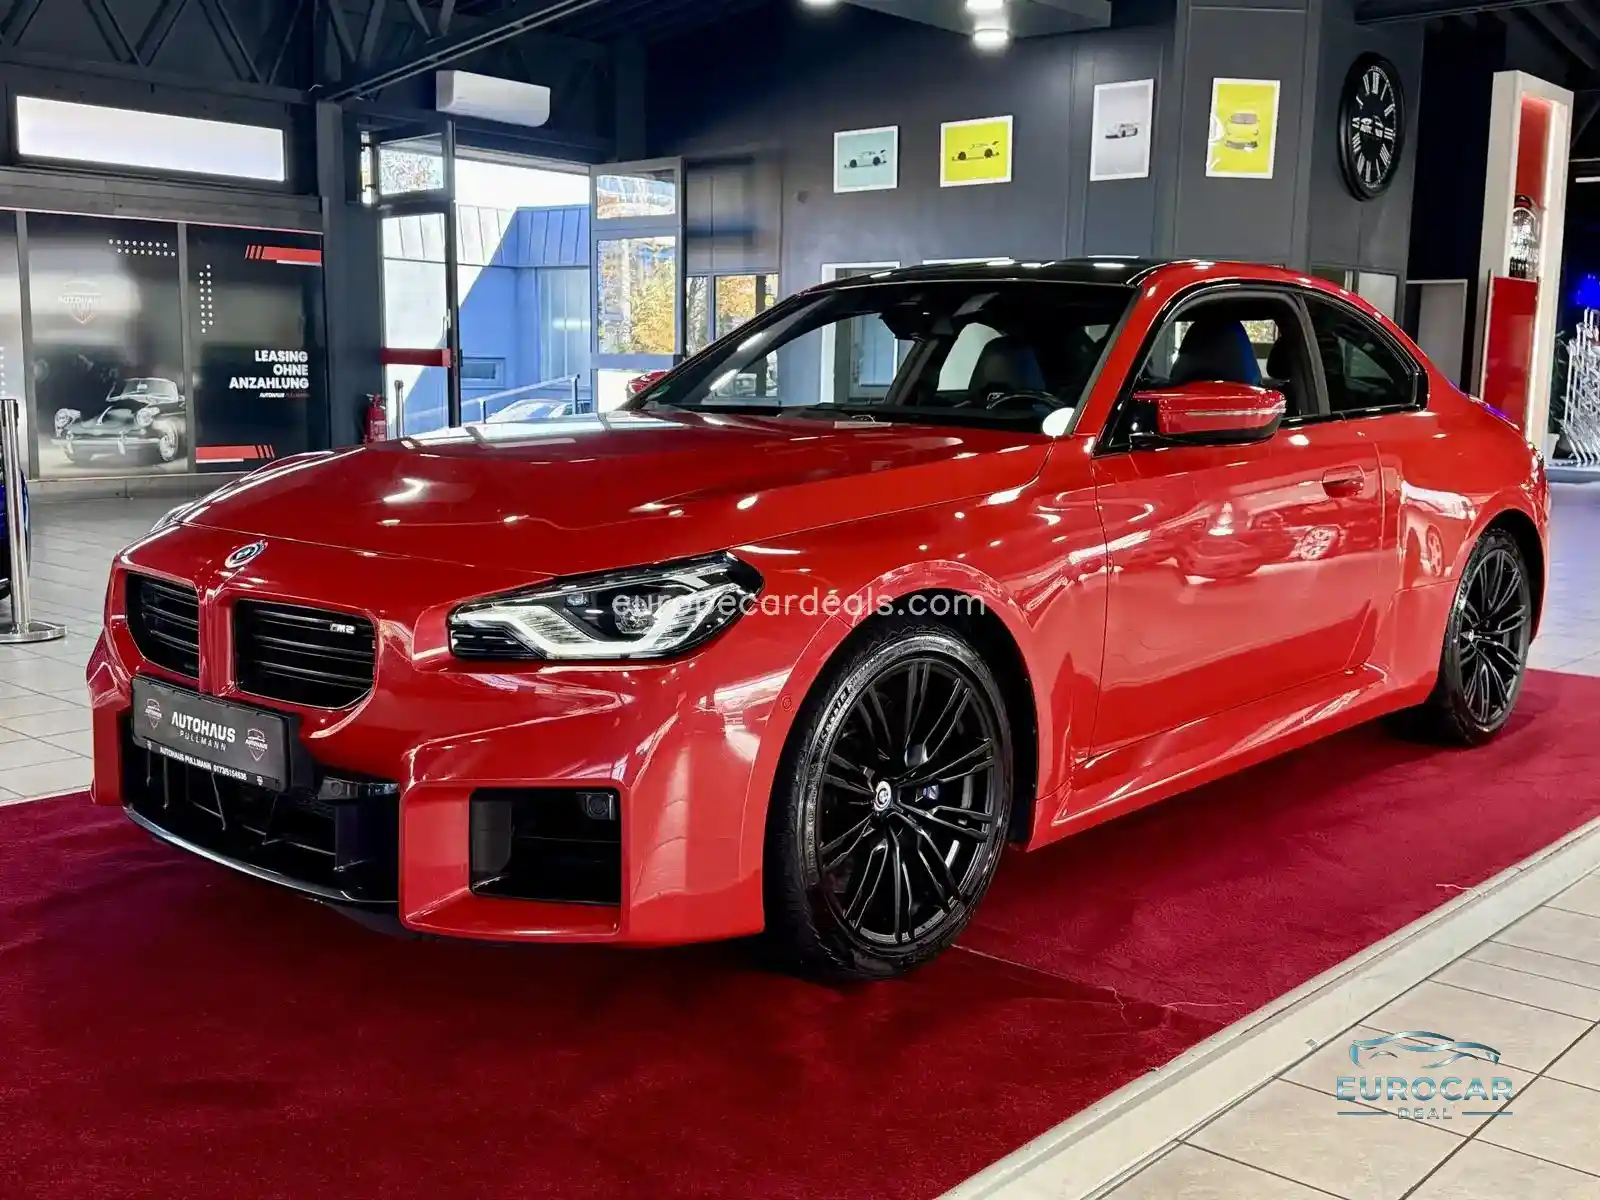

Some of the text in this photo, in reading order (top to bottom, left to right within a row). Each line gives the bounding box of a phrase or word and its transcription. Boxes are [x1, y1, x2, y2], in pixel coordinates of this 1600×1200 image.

[255, 349, 309, 363] LEASING
[272, 363, 309, 376] OHNE
[228, 376, 310, 389] ANZAHLUNG
[171, 711, 236, 743] AUTOHAUS
[179, 729, 227, 752] PULLMANN
[160, 746, 185, 761] AUTOHAUS
[185, 755, 212, 770] PULLMANN
